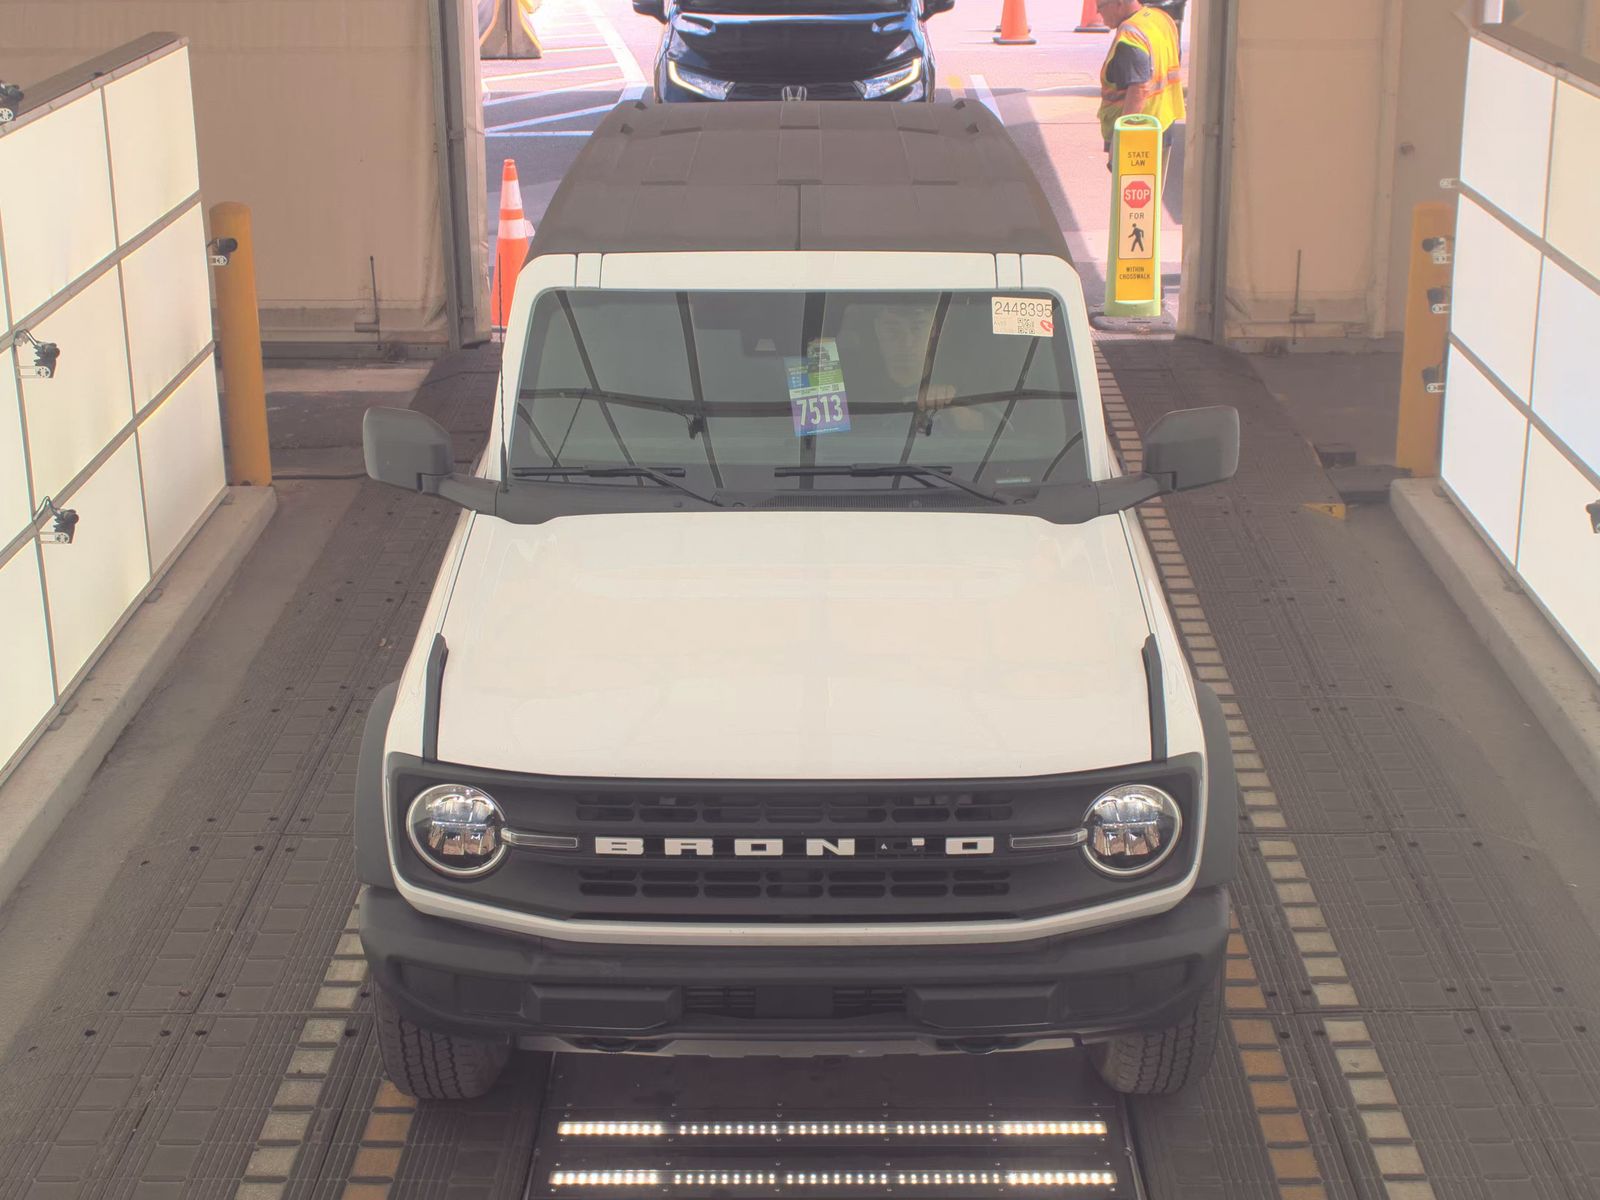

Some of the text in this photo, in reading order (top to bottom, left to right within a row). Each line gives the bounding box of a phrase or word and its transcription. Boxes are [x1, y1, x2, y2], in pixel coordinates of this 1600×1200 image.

[1128, 151, 1150, 159] STATE
[1125, 188, 1150, 201] STOP
[1129, 212, 1145, 220] FOR
[994, 301, 1053, 318] 2448395
[796, 394, 844, 426] 7513
[595, 836, 994, 857] BRONO
